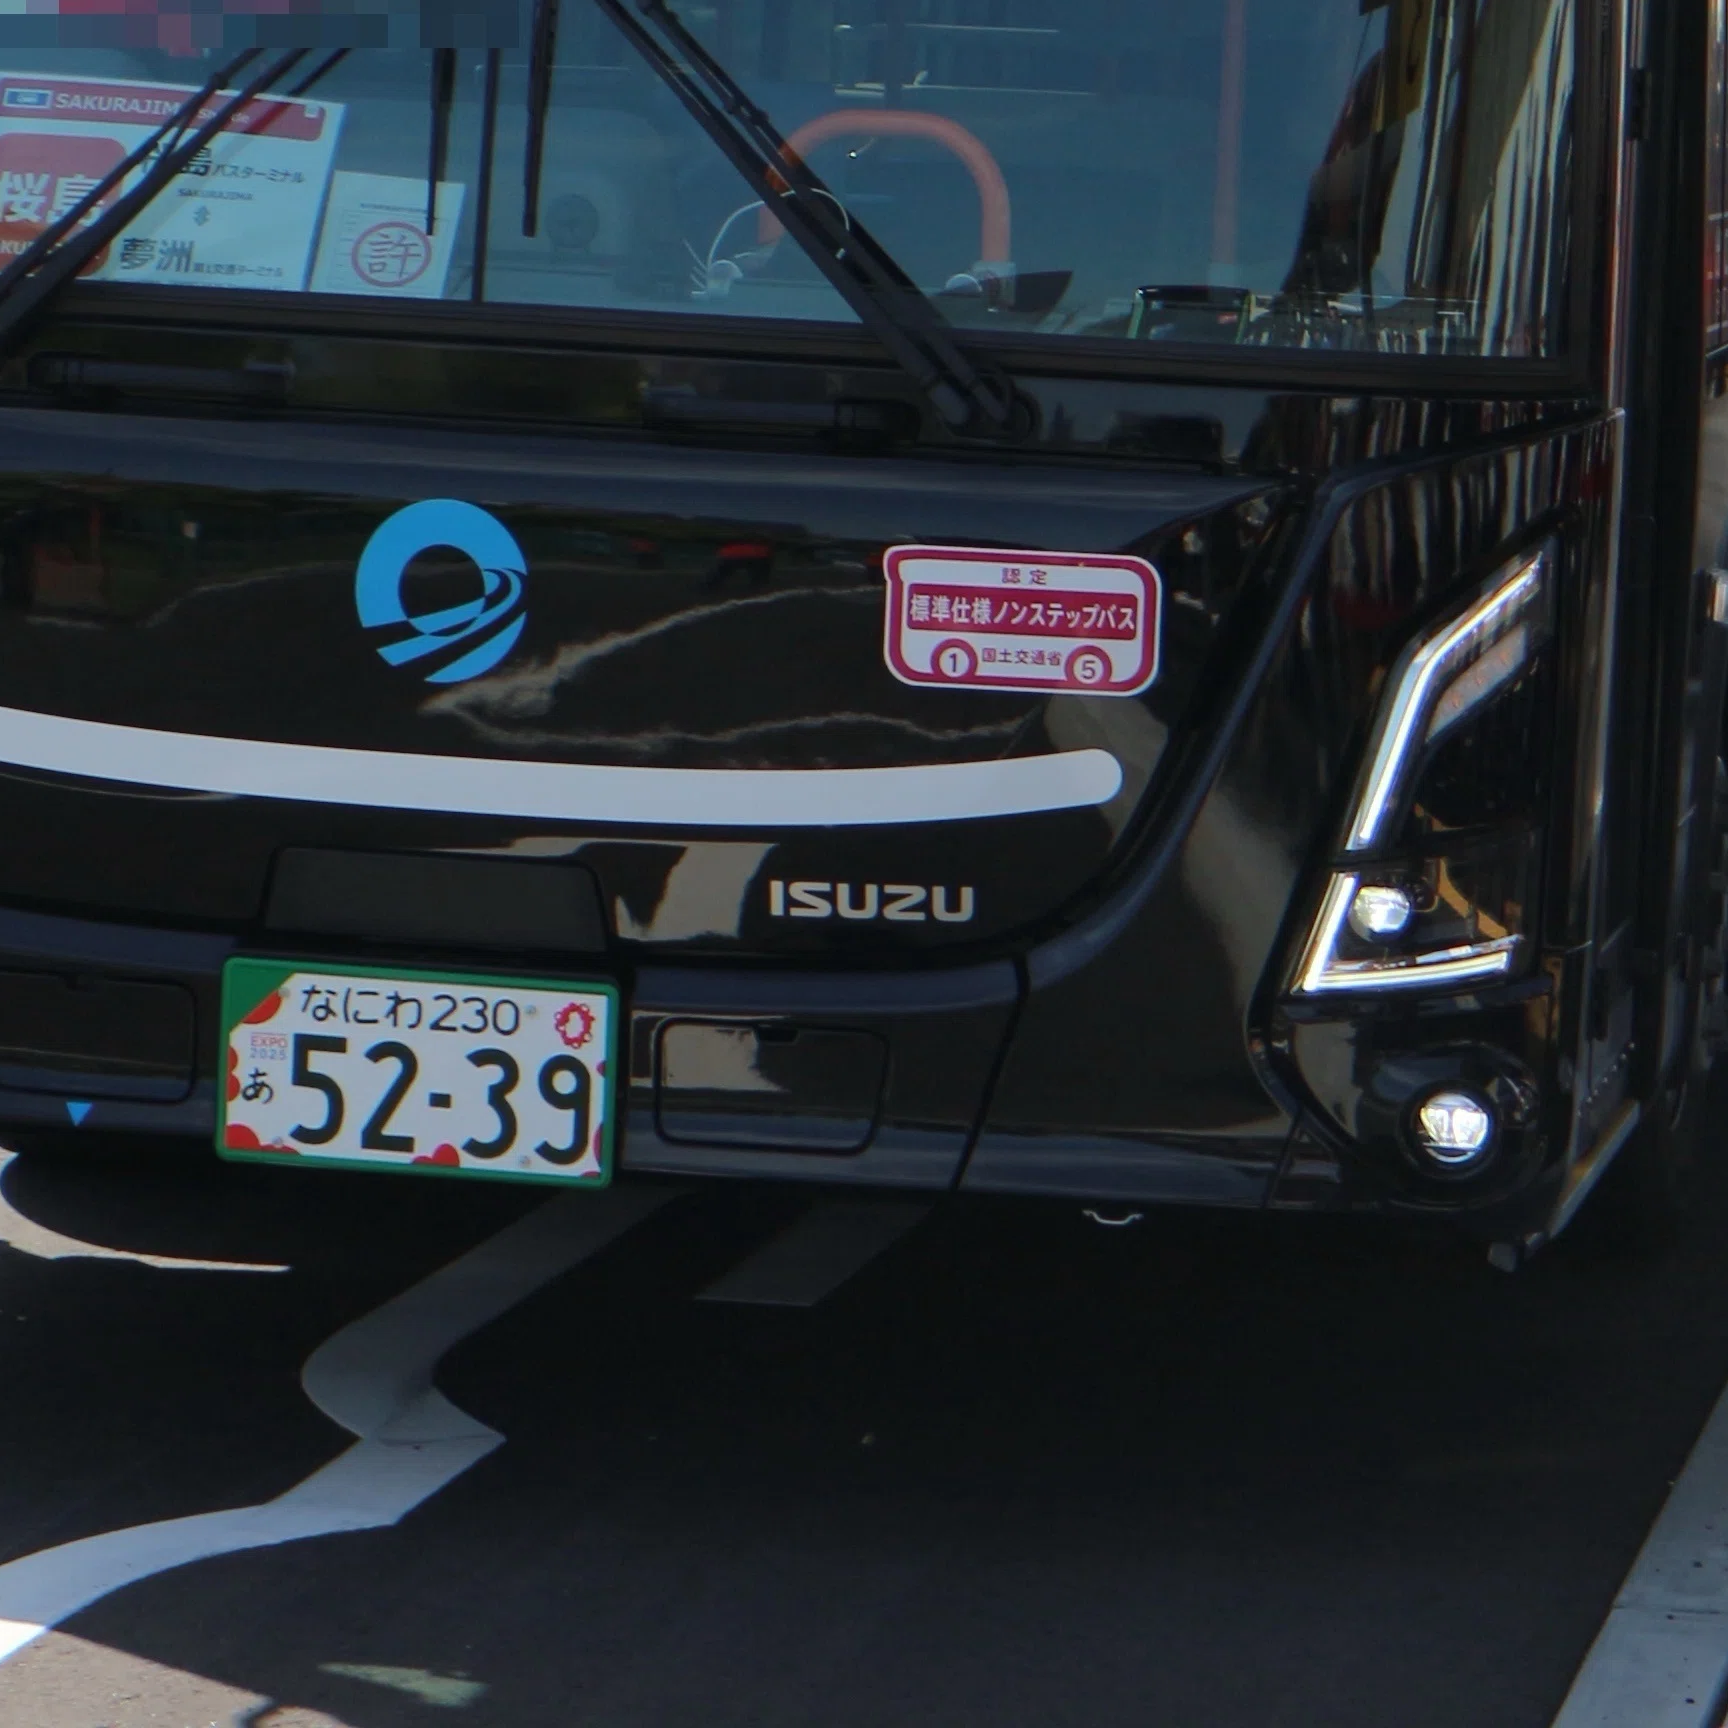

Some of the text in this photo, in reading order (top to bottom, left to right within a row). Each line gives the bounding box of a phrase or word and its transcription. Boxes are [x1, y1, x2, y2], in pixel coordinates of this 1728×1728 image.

[55, 92, 184, 116] SAKURAJIM
[1002, 567, 1048, 586] 認定
[909, 592, 1135, 631] 標準仕様ノンステップバス
[981, 647, 1063, 667] 国土交通省
[768, 879, 974, 923] ISUZU
[250, 1034, 288, 1048] EXPO
[241, 1066, 274, 1105] あ
[289, 1032, 593, 1166] 52-39
